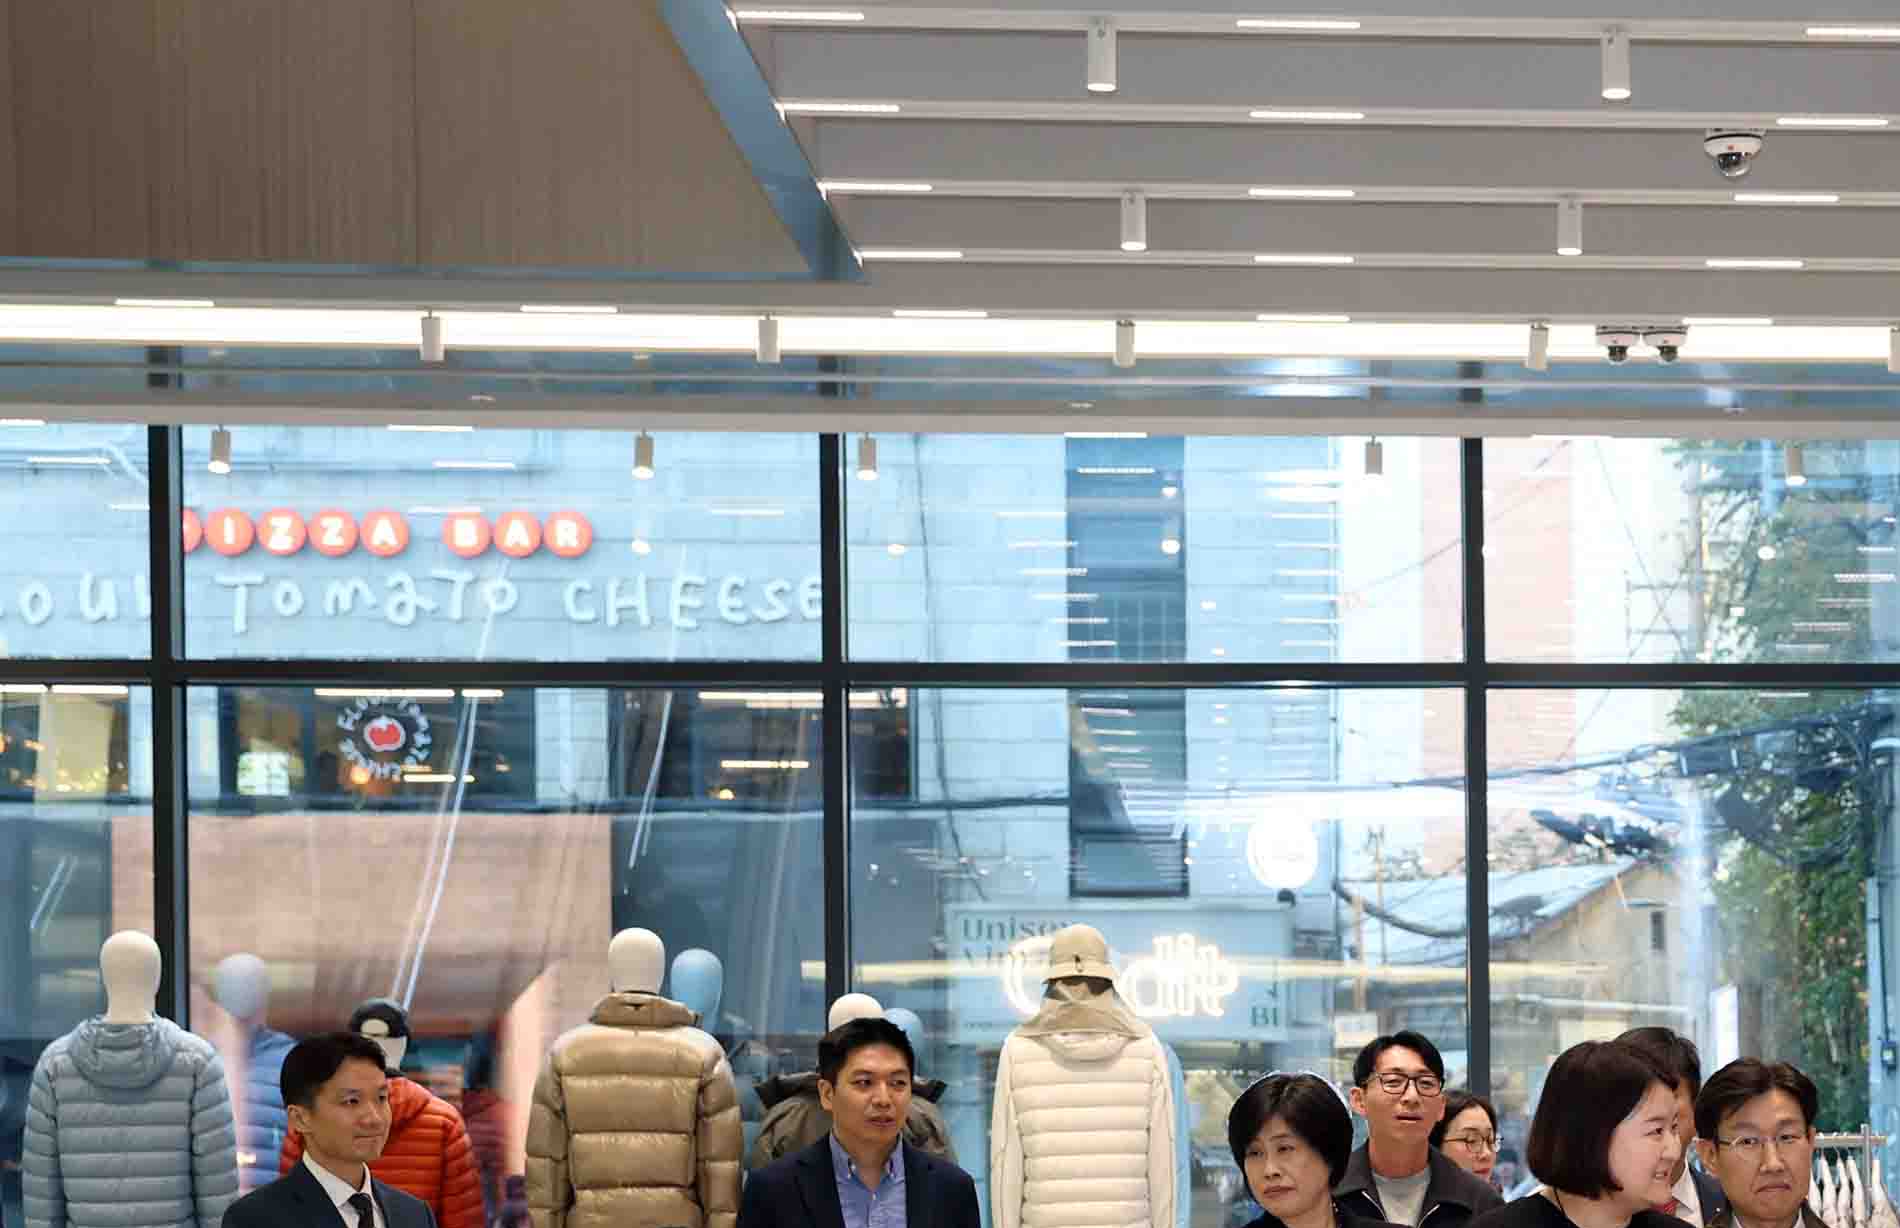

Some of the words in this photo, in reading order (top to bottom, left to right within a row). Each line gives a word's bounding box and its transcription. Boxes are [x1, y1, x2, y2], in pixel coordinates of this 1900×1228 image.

[183, 512, 404, 552] IZZA
[447, 514, 587, 553] BAR
[963, 916, 1072, 941] Unise
